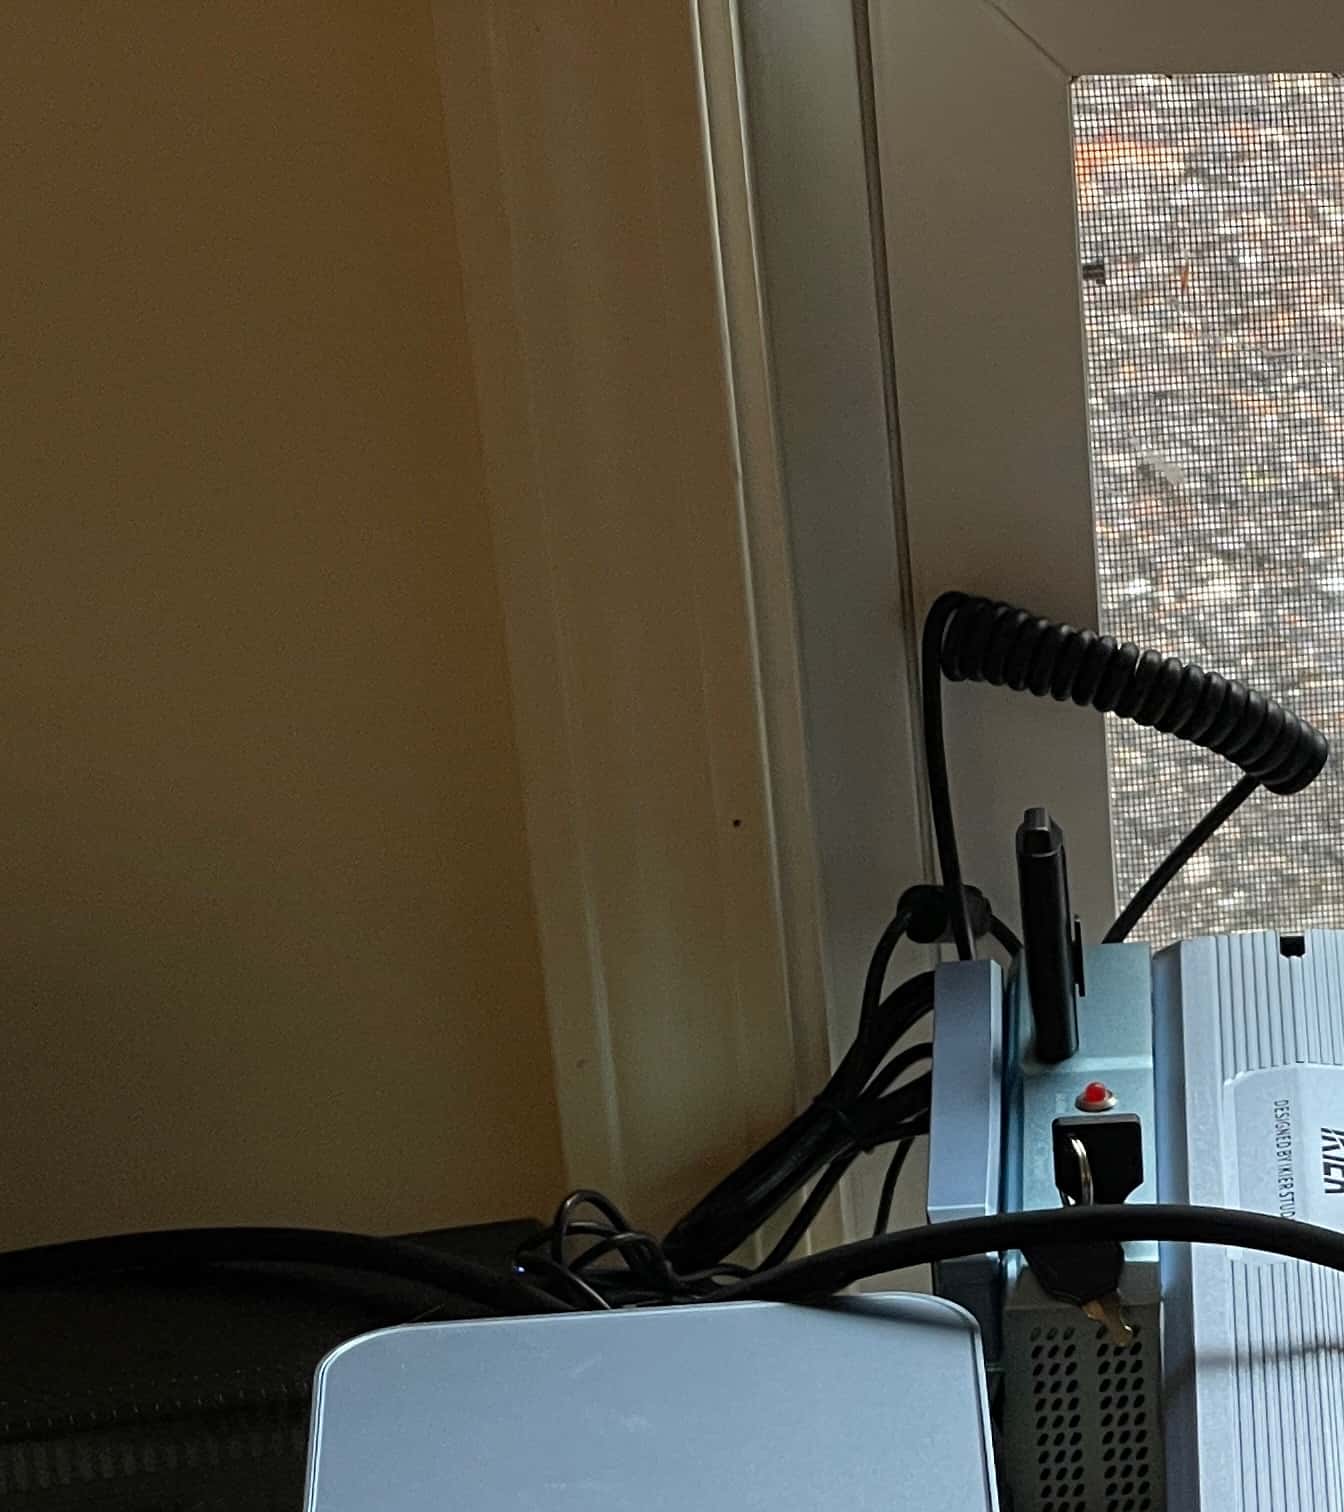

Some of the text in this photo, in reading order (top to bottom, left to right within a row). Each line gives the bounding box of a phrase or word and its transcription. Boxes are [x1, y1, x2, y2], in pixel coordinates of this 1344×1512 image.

[1274, 1099, 1292, 1149] DESIGNED
[1277, 1149, 1292, 1162] BY
[1279, 1163, 1294, 1191] IKIER
